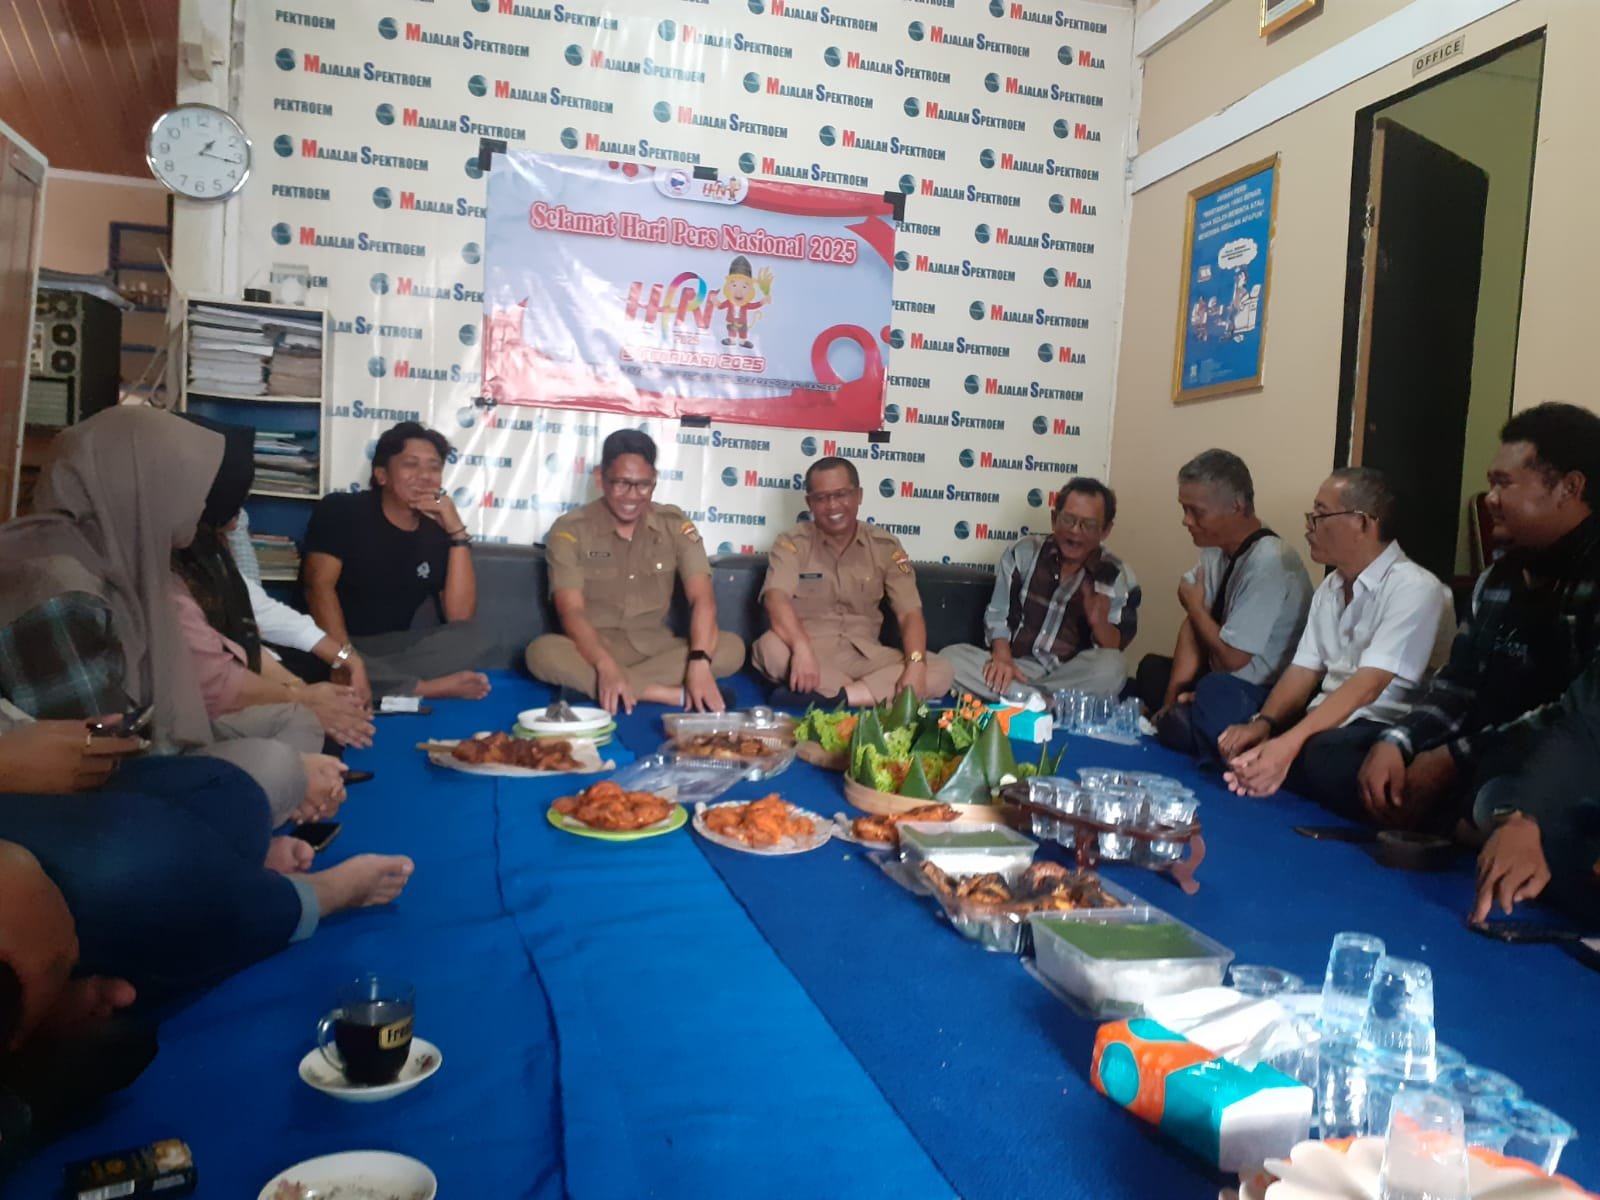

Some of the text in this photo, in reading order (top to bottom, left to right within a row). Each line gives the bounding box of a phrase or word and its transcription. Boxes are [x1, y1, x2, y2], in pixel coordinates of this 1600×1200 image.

[276, 10, 335, 30] PEKTROEM
[498, 0, 551, 20] MAJALAH
[771, 0, 877, 32] MAJALAH SPEKTROEM
[1011, 3, 1107, 34] MAJALAH SPEKTROEM
[406, 23, 529, 57] MAJALAH SPEKTROEM
[734, 33, 792, 58] SPEKTROEM
[931, 26, 1030, 57] MAJALAH SPEKTROEM
[591, 51, 640, 73] MAJALAH
[1079, 50, 1105, 69] MAJA
[1416, 40, 1460, 70] OFFICE
[304, 54, 431, 88] MAJALAH SPEKTROEM
[847, 52, 950, 83] MAJALAH SPEKTROEM
[495, 80, 613, 113] MAJALAH SPEKTROEM
[767, 77, 873, 108] MAJALAH SPEKTROEM
[1006, 77, 1103, 106] MAJALAH SPEKTROEM
[274, 98, 332, 116] PEKTROEM
[926, 102, 1025, 131] MAJALAH SPEKTROEM
[181, 117, 190, 128] 11
[403, 108, 525, 140] MAJALAH SPEKTROEM
[679, 107, 787, 138] MAJALAH SPEKTROEM
[1075, 123, 1101, 142] MAJA
[160, 142, 170, 154] 9
[302, 139, 428, 171] MAJALAH SPEKTROEM
[585, 133, 700, 164] MAJALAH SPEKTROEM
[842, 130, 945, 160] MAJALAH SPEKTROEM
[164, 160, 174, 172] 8
[227, 170, 236, 179] 4
[762, 157, 868, 188] MAJALAH SPEKTROEM
[1001, 153, 1099, 180] MAJALAH SPEKTROEM
[180, 175, 188, 186] 7
[195, 180, 205, 192] 6
[212, 180, 223, 191] 5
[272, 184, 330, 200] PEKTROEM
[400, 192, 453, 214] MAJALAH
[921, 179, 1020, 207] MAJALAH SPEKTROEM
[1070, 198, 1096, 216] MAJA
[300, 227, 425, 256] MAJALAH SPEKTROEM
[530, 200, 859, 266] Selamat Hari Pers Nasional 2025
[996, 228, 1094, 254] MAJALAH SPEKTROEM
[916, 255, 1015, 281] MAJALAH SPEKTROEM
[1065, 272, 1091, 289] MAJA
[991, 305, 1089, 329] MAJALAH SPEKTROEM
[911, 333, 1010, 357] MAJALAH SPEKTROEM
[1059, 347, 1086, 364] MAJA
[718, 354, 766, 373] 2025
[986, 378, 1083, 401] MAJALAH SPEKTROEM
[353, 400, 419, 421] SPEKTROEM
[906, 407, 1004, 430] MAJALAH SPEKTROEM
[1054, 419, 1080, 436] MAJA
[712, 431, 769, 451] SPEKTROEM
[822, 440, 925, 463] MAJALAH SPEKTROEM
[981, 452, 1078, 473] MAJALAH SPEKTROEM
[745, 471, 790, 489] MAJALAH
[901, 482, 999, 503] MAJALAH SPEKTROEM
[708, 506, 766, 526] SPEKTROEM
[976, 524, 1018, 540] MAJALAH
